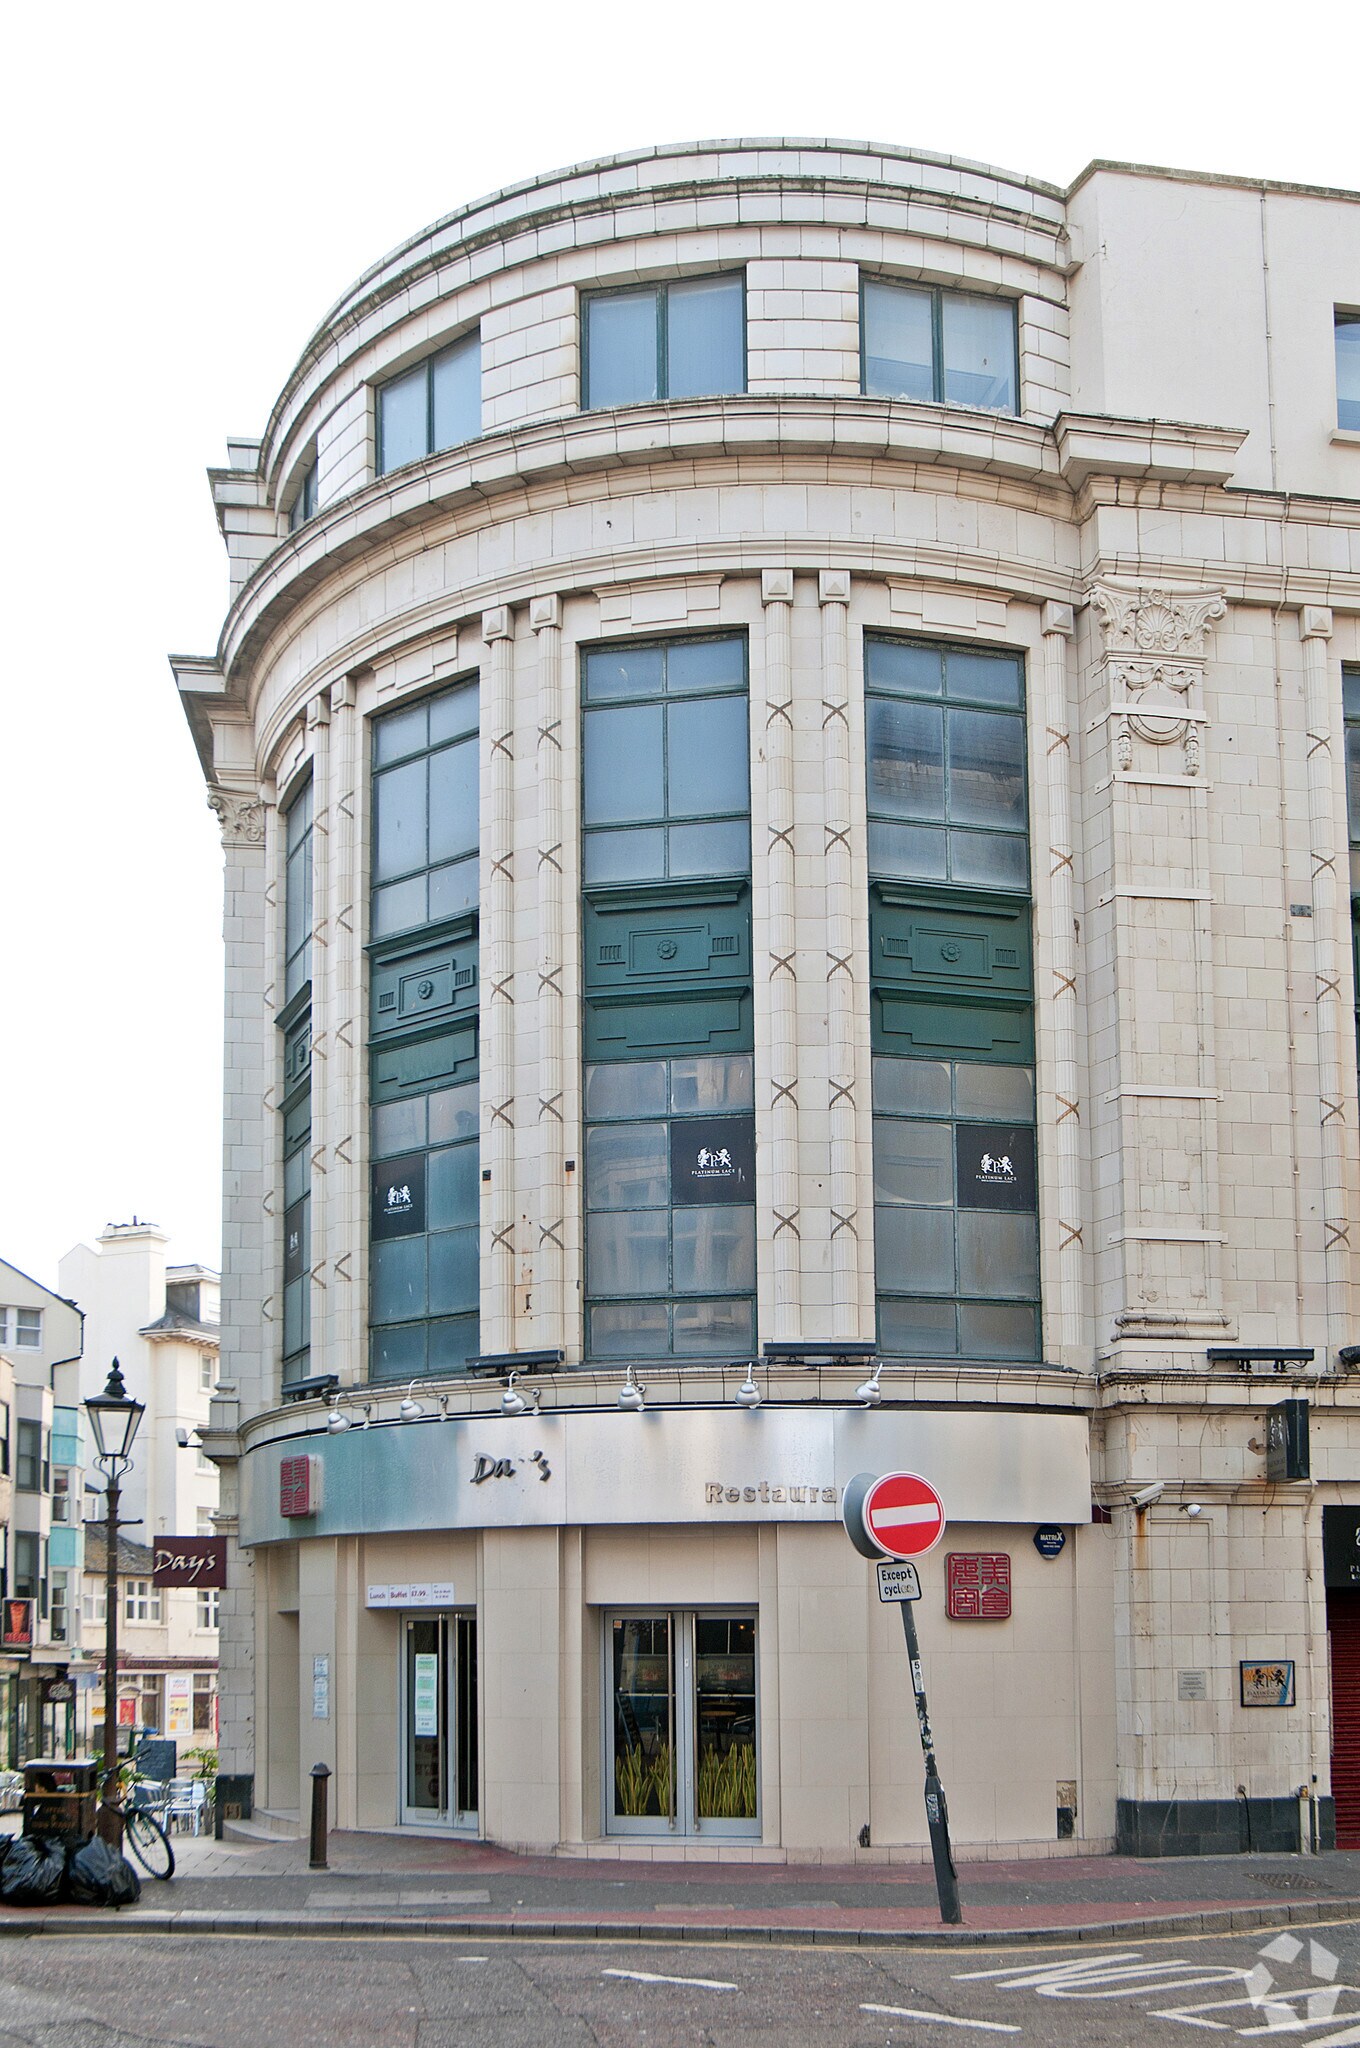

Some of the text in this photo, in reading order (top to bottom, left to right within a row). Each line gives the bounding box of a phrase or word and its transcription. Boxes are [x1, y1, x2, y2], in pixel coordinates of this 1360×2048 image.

[470, 1450, 551, 1485] Da's
[705, 1481, 844, 1503] Restaura
[881, 1568, 912, 1581] Except
[914, 1660, 920, 1670] 5
